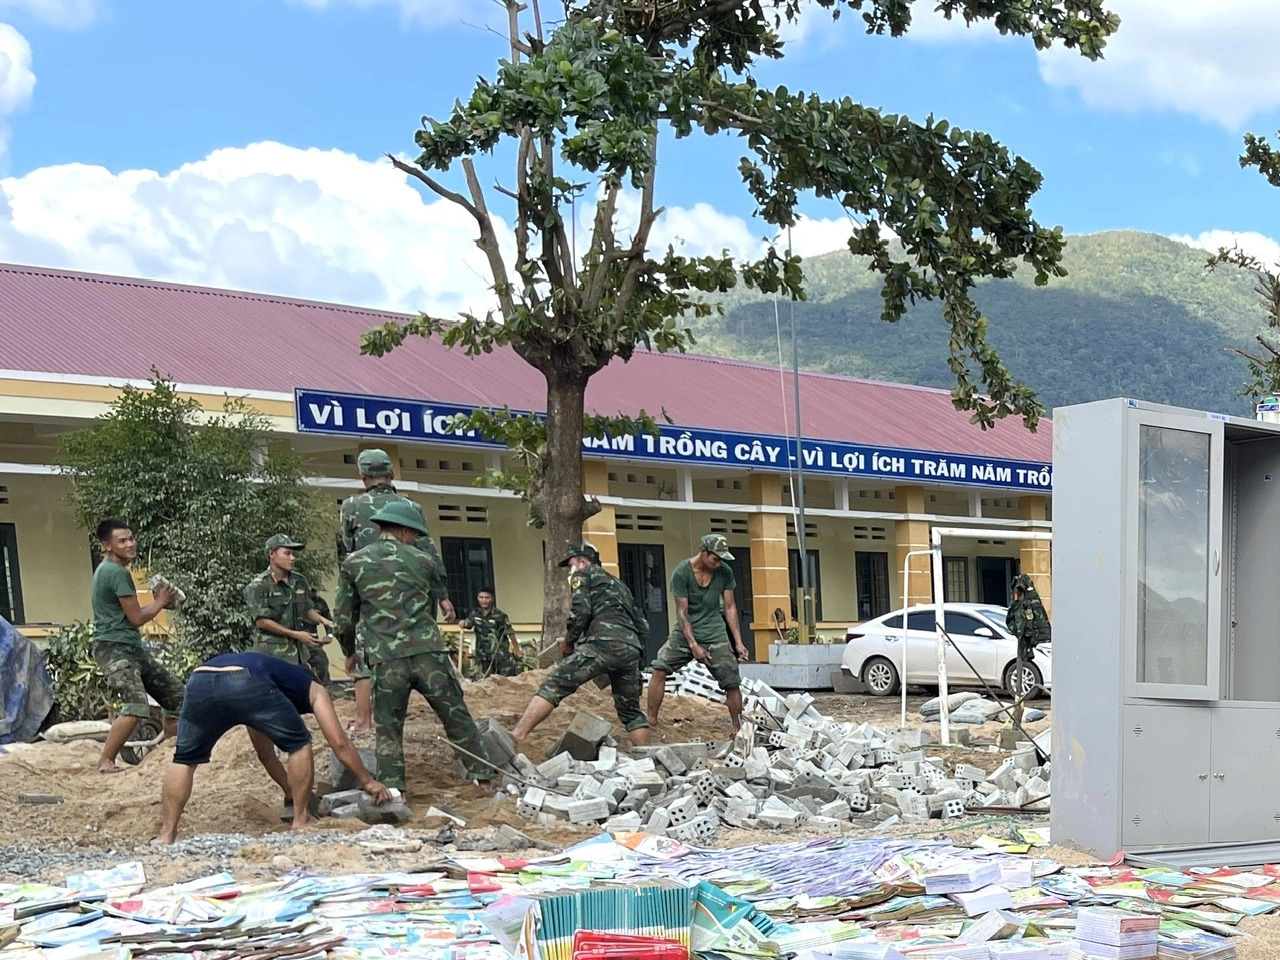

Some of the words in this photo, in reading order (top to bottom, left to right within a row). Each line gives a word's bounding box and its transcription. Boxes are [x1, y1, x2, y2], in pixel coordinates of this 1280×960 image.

[308, 400, 343, 427] VÌ
[356, 407, 411, 434] LỢI
[642, 431, 728, 459] TRỒNG
[734, 440, 781, 463] CÂY
[802, 445, 824, 467] VÌ
[831, 451, 865, 472] LỢI
[872, 452, 905, 474] ÍCH
[911, 457, 966, 478] TRĂM
[971, 462, 1011, 482] NĂM
[1016, 466, 1053, 487] TRỒ
